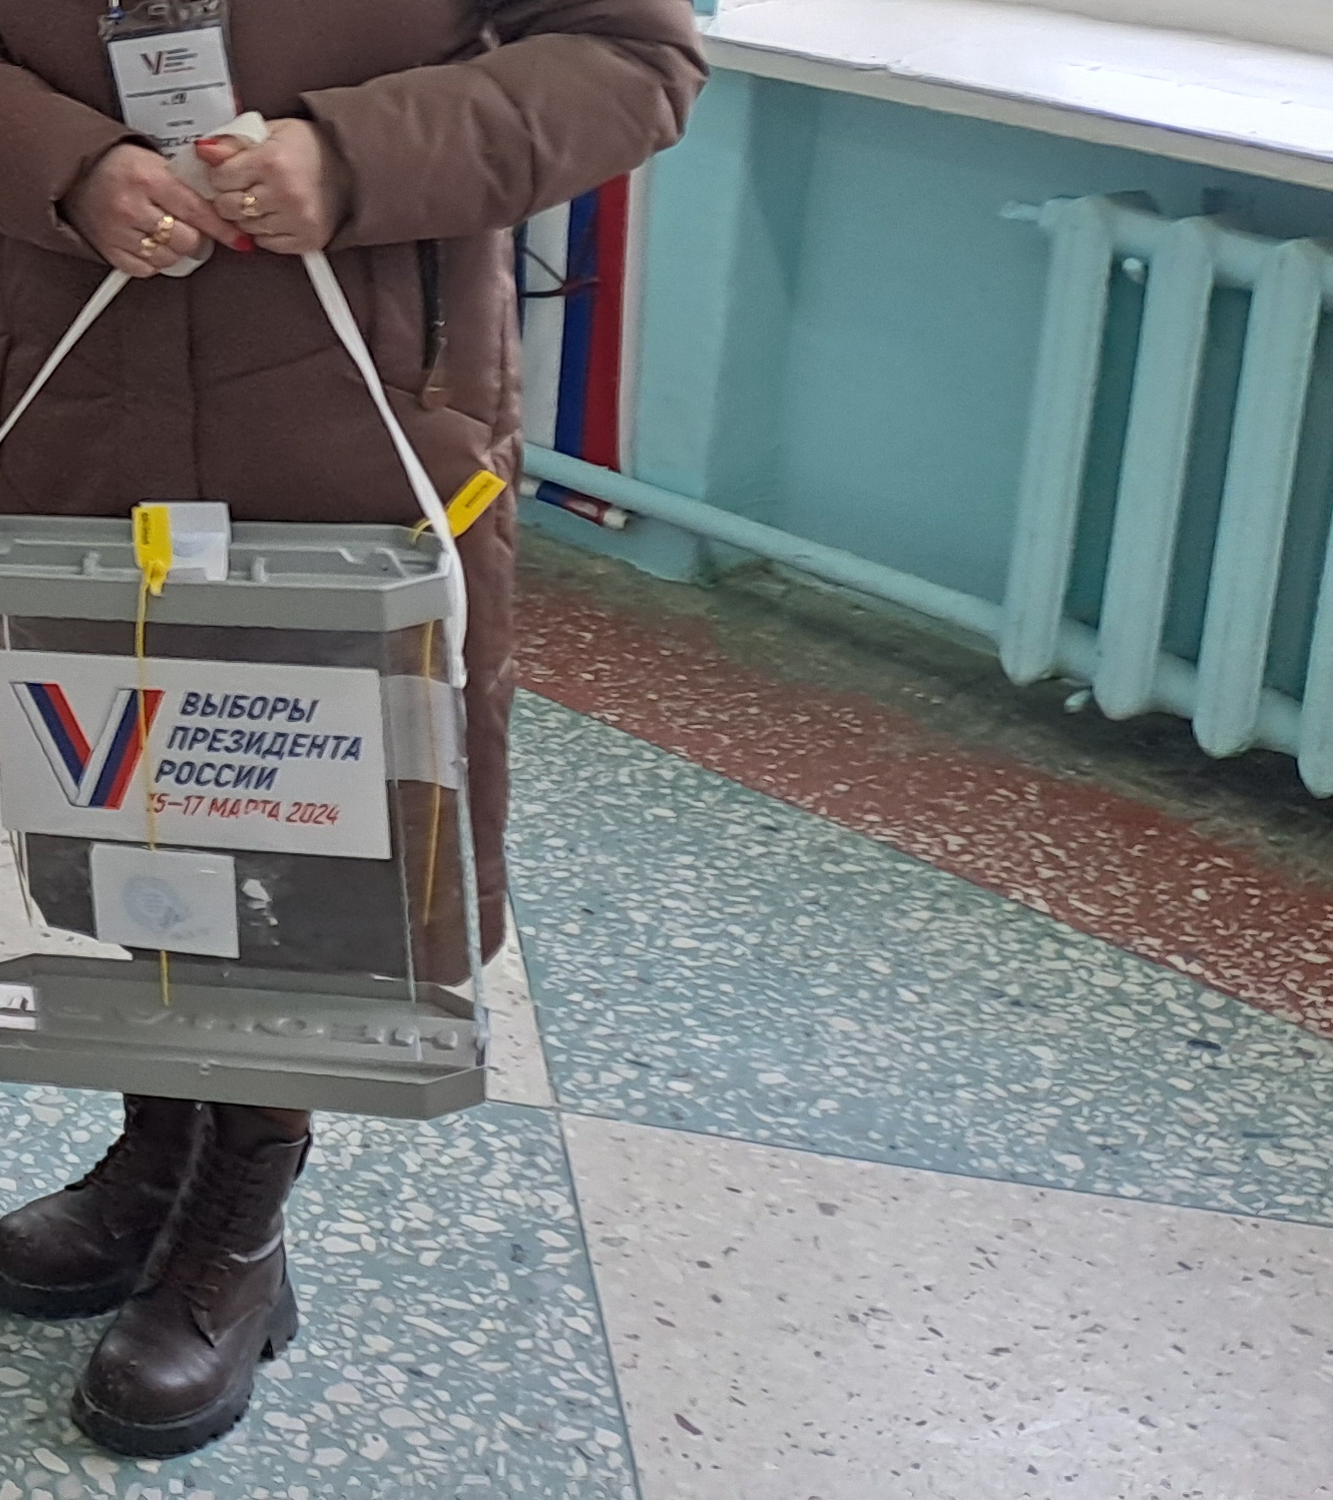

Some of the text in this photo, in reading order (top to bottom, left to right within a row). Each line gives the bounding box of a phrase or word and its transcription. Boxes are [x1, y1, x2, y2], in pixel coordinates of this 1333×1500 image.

[180, 691, 321, 723] ВЫБОРЫ
[166, 726, 363, 761] ПРЕЗИДЕНТА
[154, 759, 280, 791] РОССИИ
[208, 797, 281, 822] МАРТА
[285, 801, 341, 826] 2024
